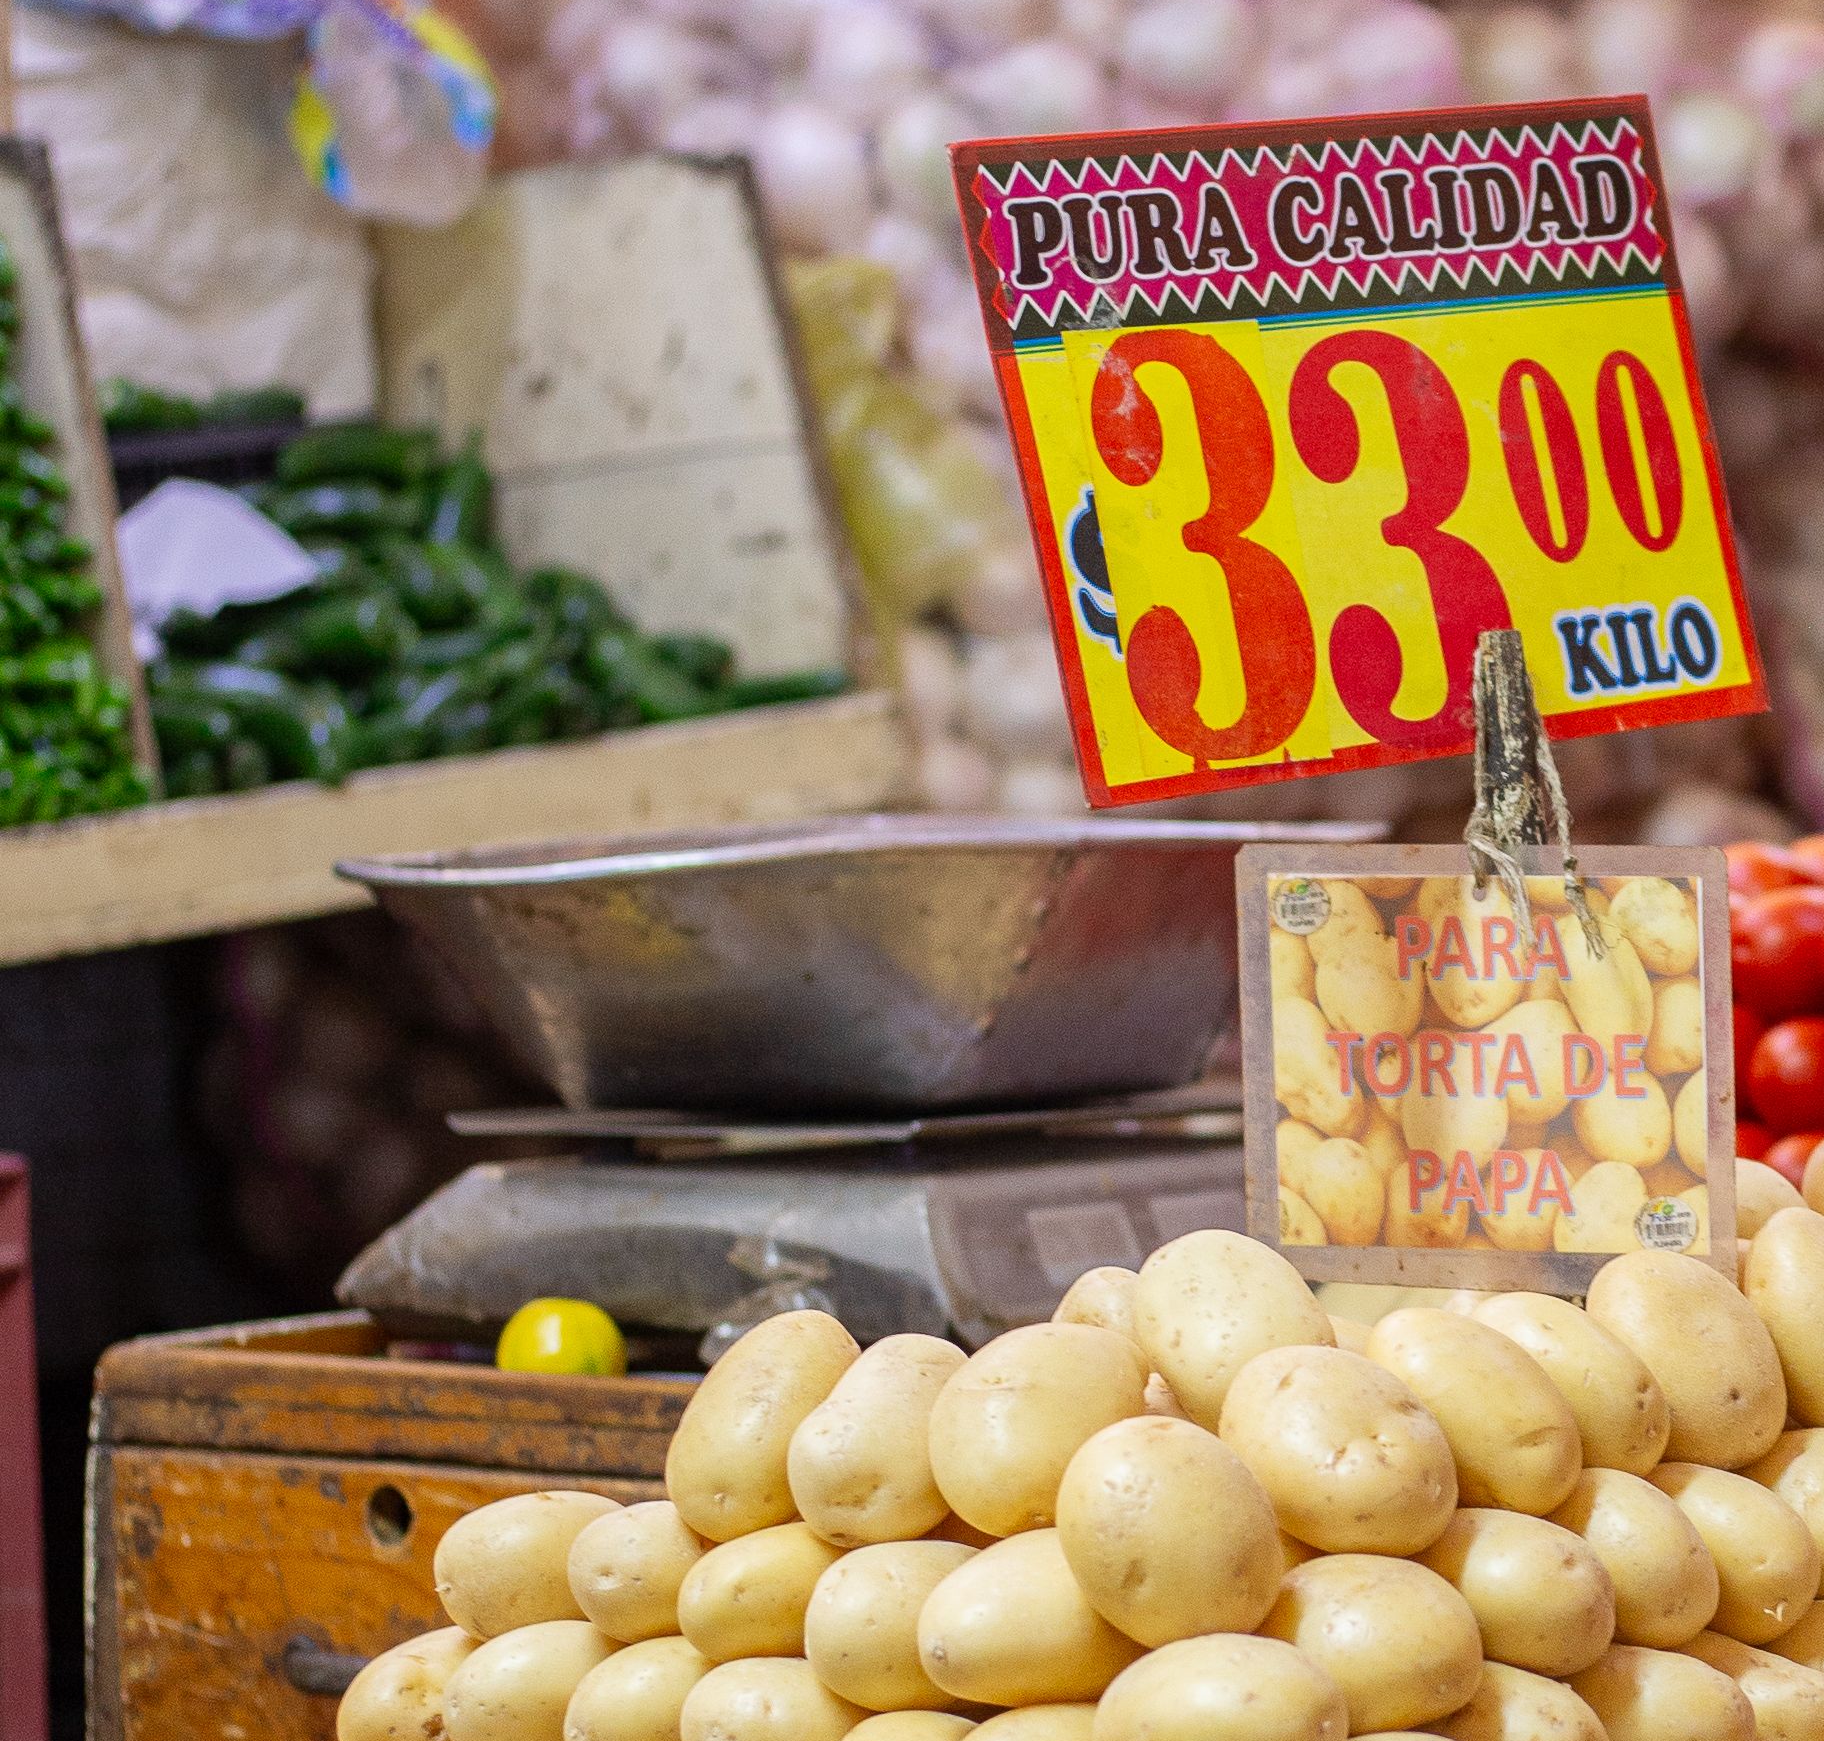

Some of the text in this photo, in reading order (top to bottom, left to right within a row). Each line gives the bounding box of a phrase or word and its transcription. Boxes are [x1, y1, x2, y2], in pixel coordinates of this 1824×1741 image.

[1005, 154, 1639, 290] PURA CALIDAD
[1556, 600, 1721, 697] KILO
[1396, 915, 1572, 981] PARA
[1325, 1031, 1650, 1099] TORTA DE
[1407, 1149, 1576, 1217] PAPA
